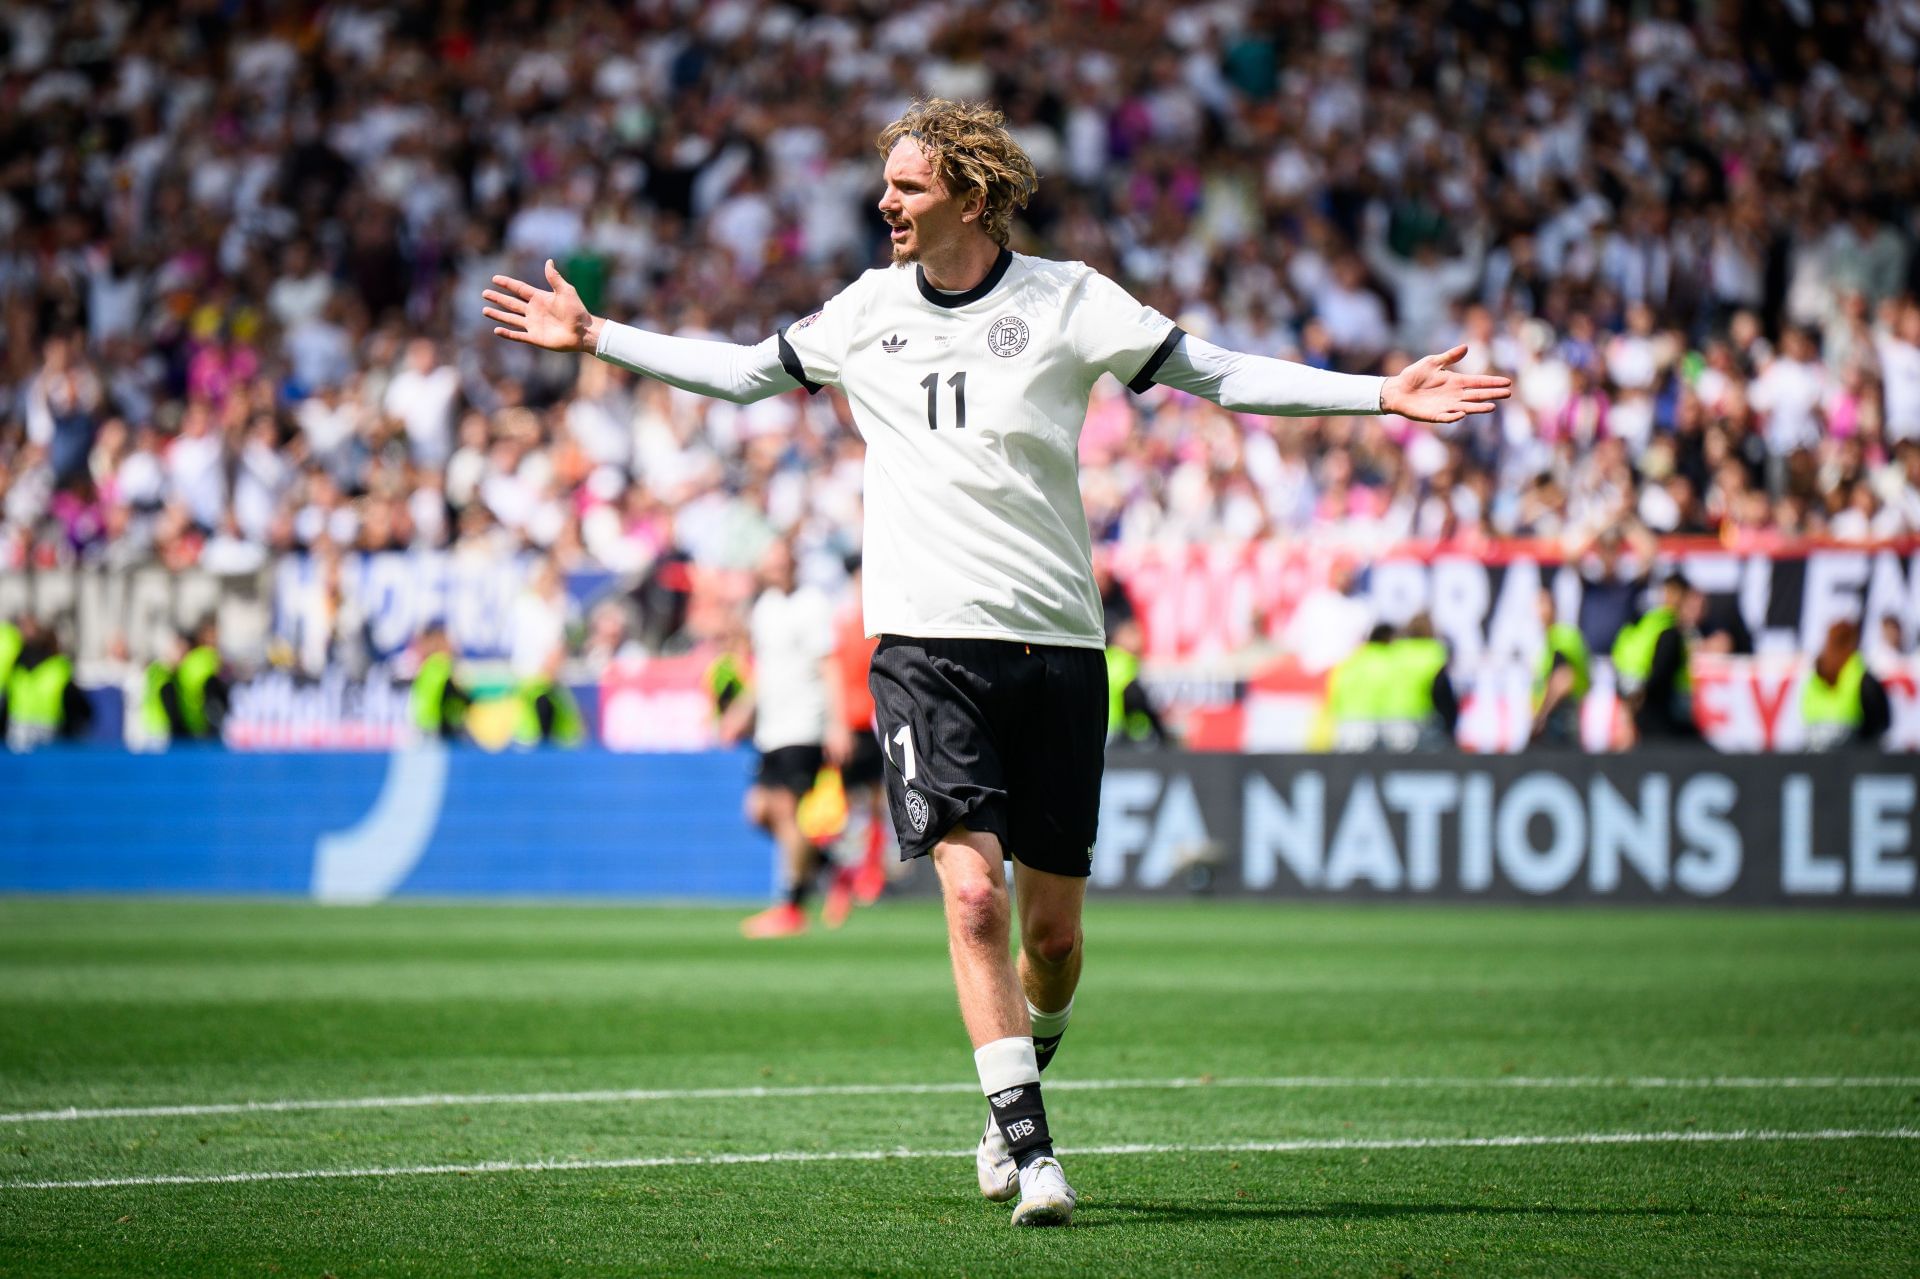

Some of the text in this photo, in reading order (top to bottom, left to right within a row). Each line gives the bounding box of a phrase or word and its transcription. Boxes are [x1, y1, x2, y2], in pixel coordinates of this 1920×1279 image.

[920, 371, 966, 430] 11
[1091, 769, 1213, 890] FA
[1242, 769, 1743, 895] NATIONS
